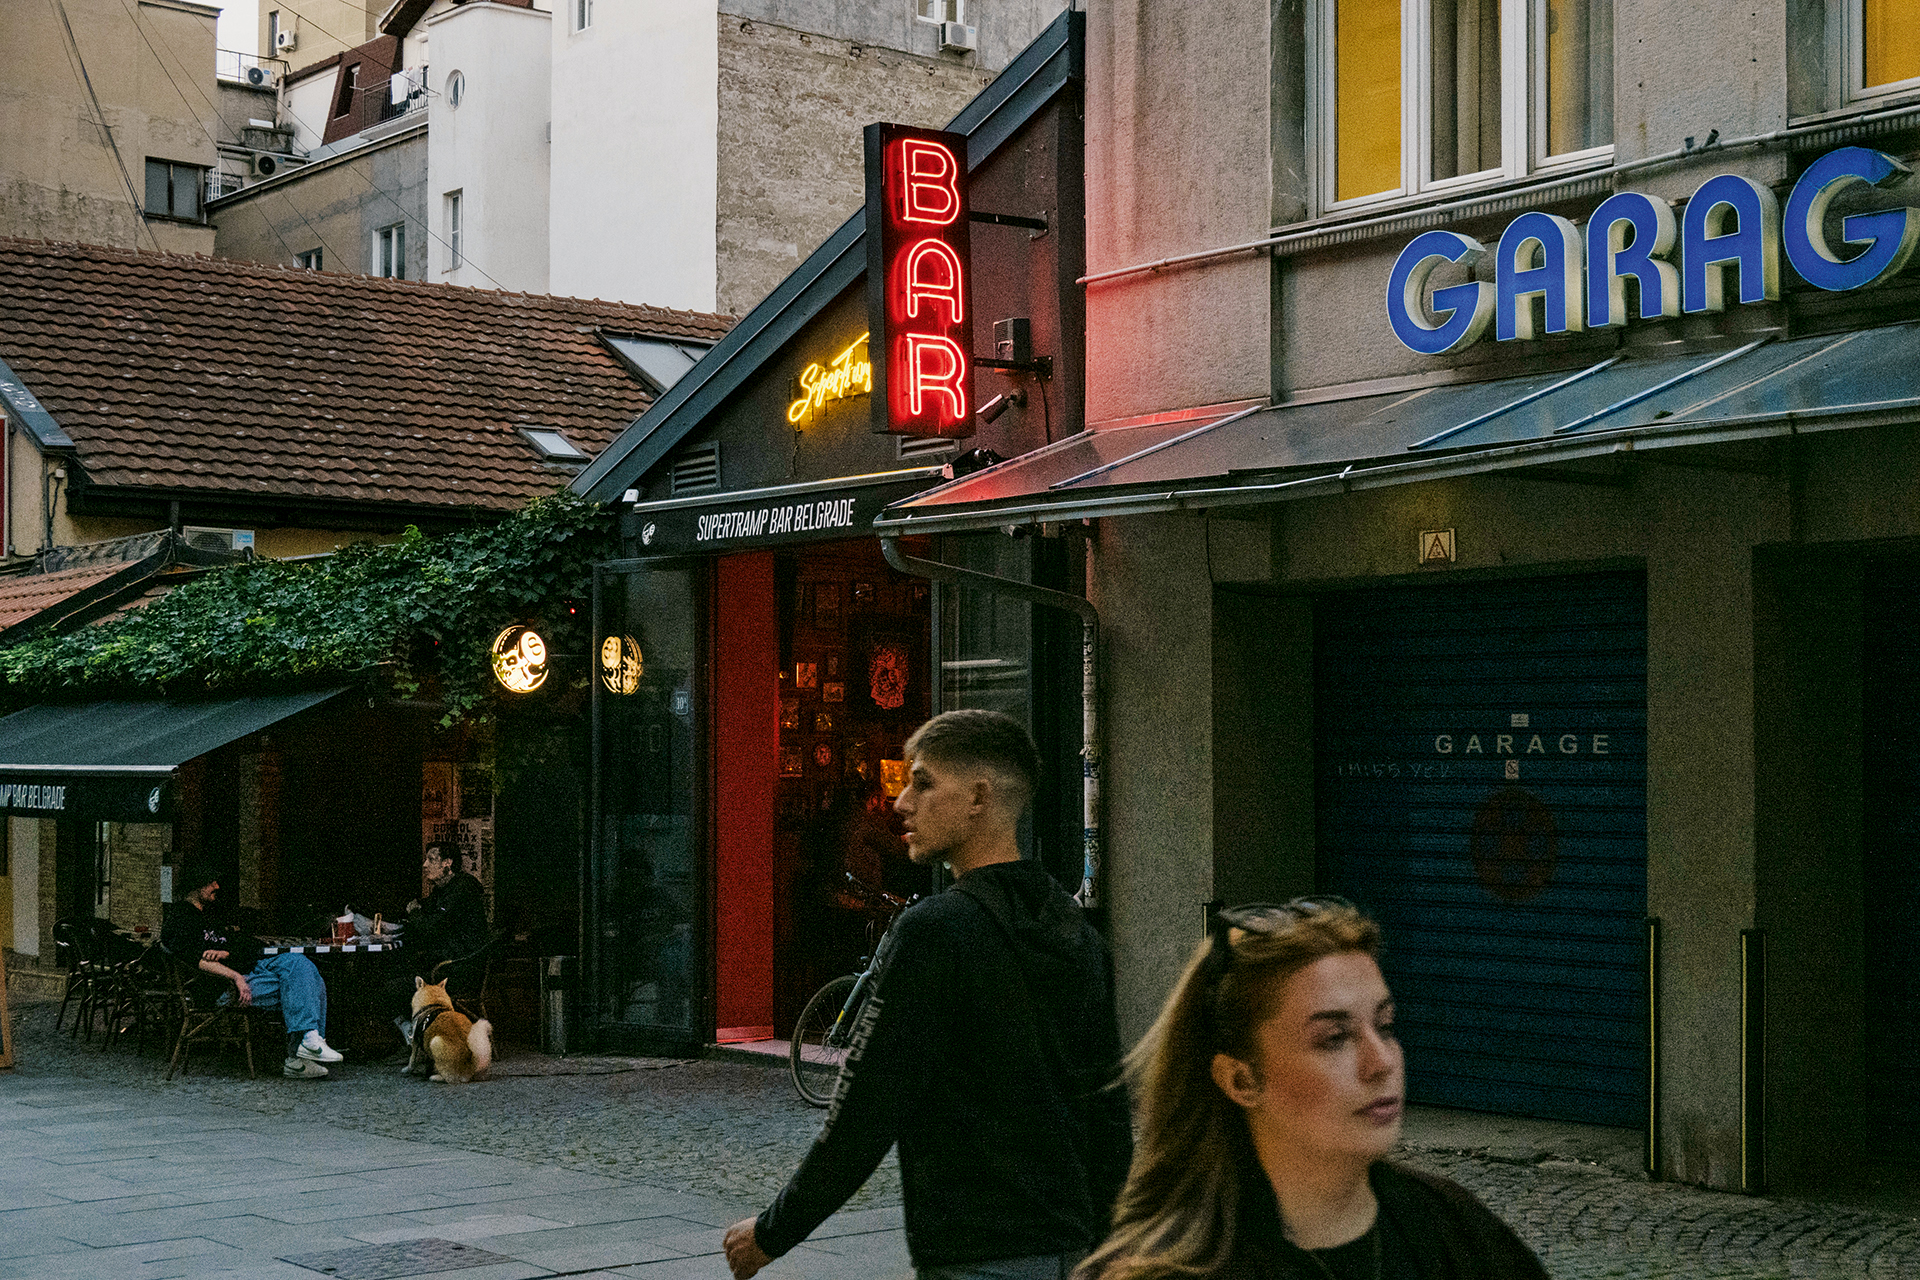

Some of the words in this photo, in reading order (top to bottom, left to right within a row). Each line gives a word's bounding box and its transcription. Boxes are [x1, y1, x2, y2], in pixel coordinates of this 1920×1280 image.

[902, 138, 967, 420] BAR
[697, 509, 768, 541] SUPERTRAMP
[769, 506, 794, 534] BAR
[794, 498, 856, 532] BELGRADE
[1434, 734, 1610, 755] GARAGE
[12, 784, 28, 808] BAR
[27, 785, 66, 810] BELGRADE
